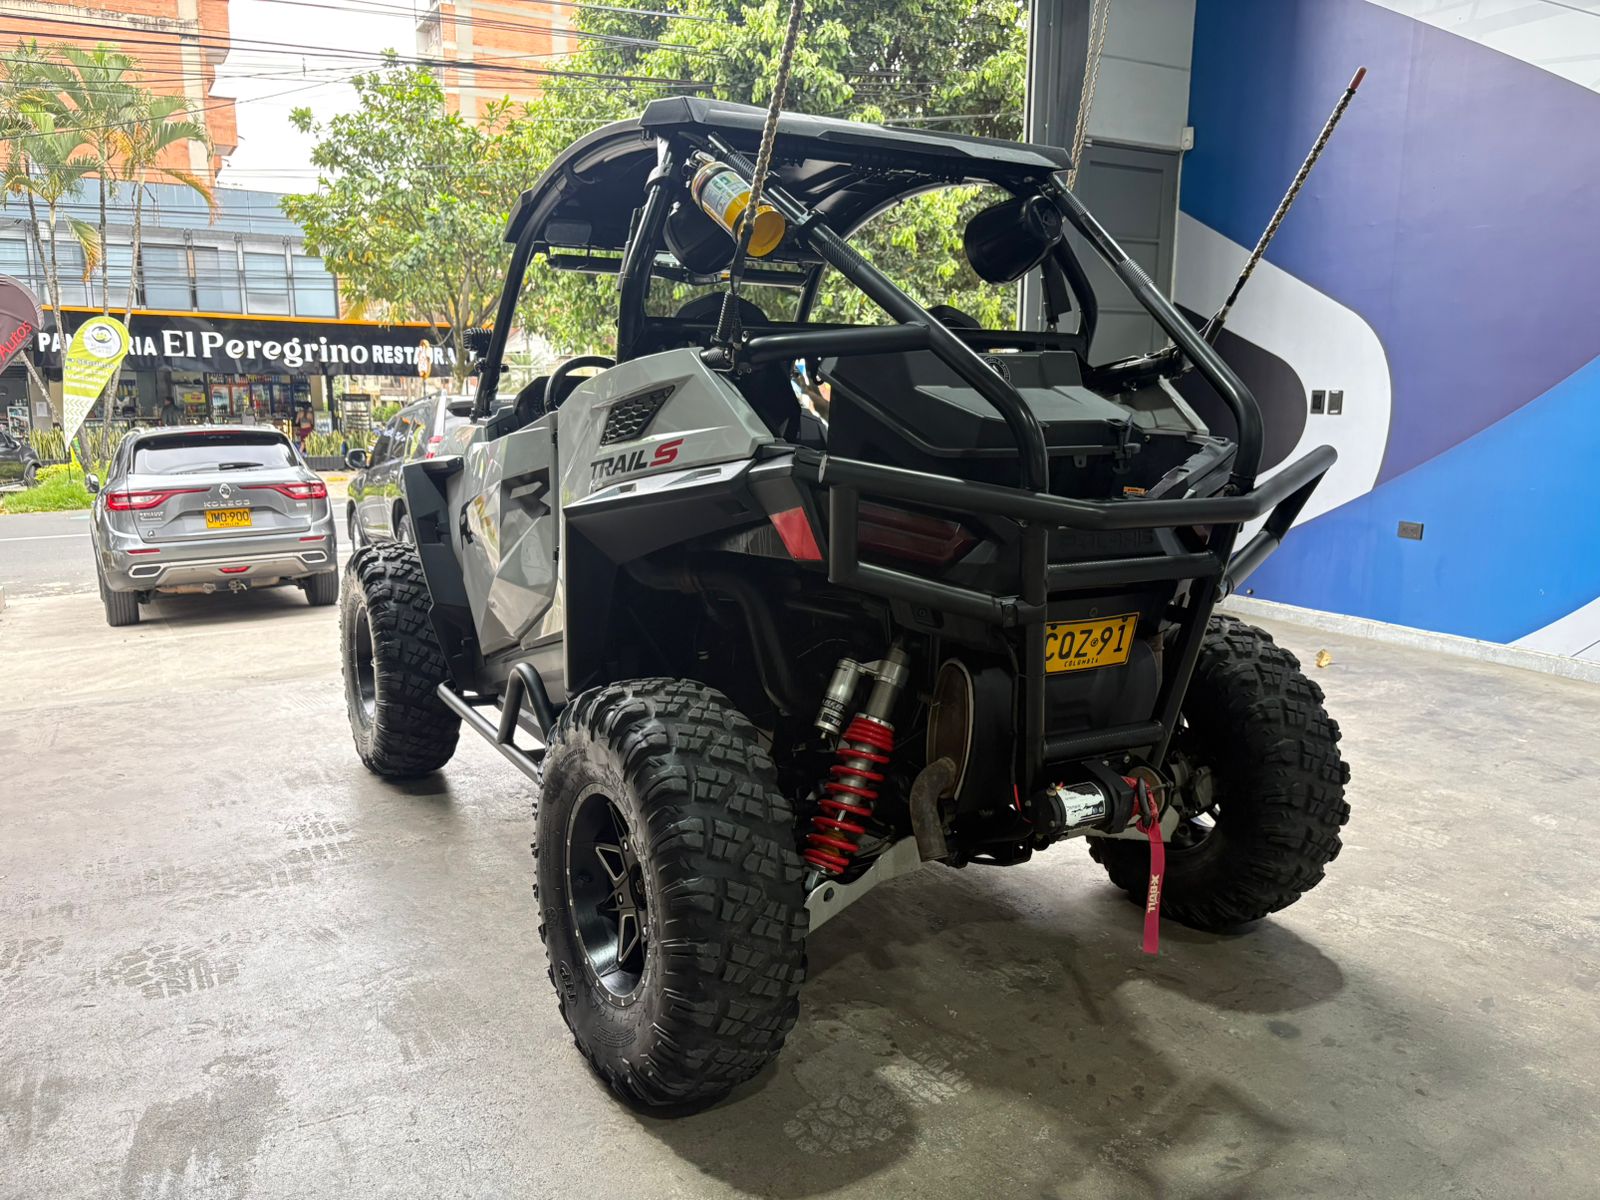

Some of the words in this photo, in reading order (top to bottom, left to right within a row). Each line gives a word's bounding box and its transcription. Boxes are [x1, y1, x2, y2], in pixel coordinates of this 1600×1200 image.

[161, 330, 196, 358] El
[200, 331, 369, 368] Peregrino
[590, 450, 648, 480] TRAIL
[649, 438, 684, 467] S
[1064, 657, 1099, 668] COLOMBIA
